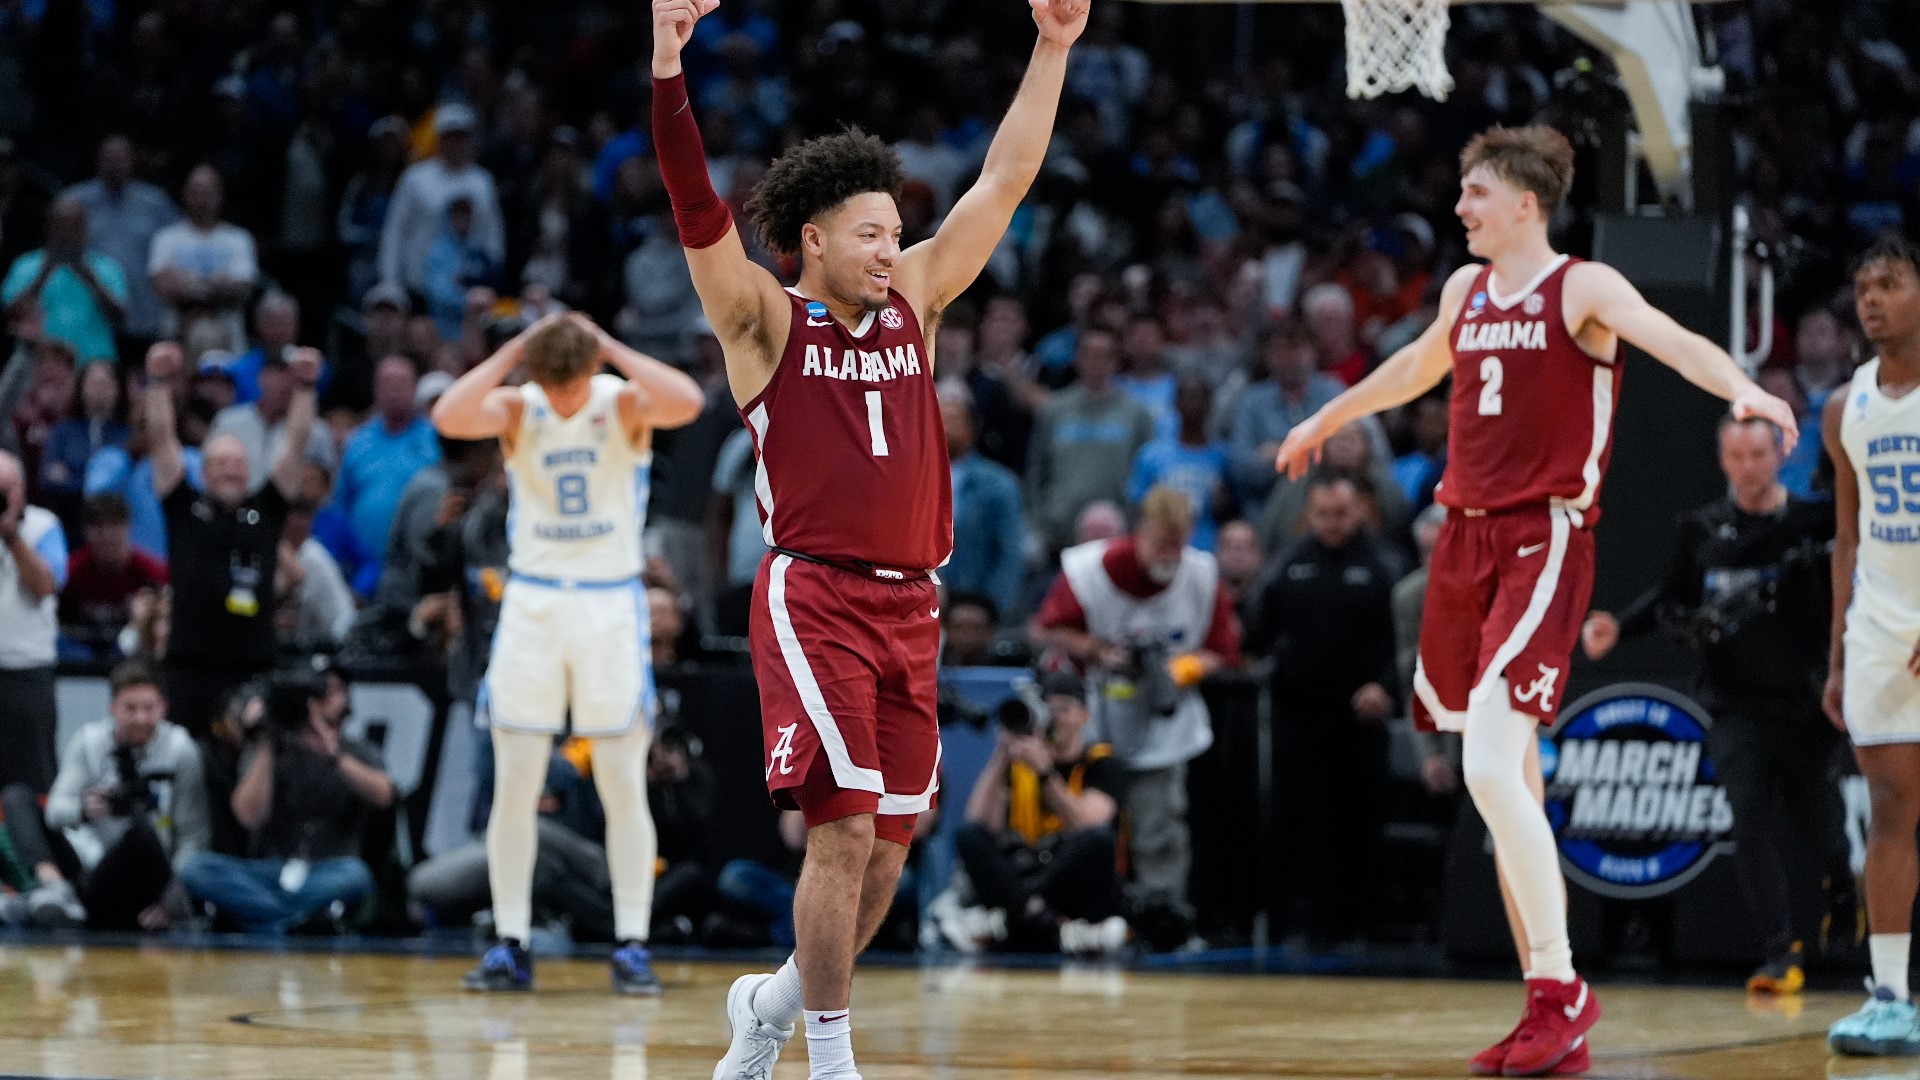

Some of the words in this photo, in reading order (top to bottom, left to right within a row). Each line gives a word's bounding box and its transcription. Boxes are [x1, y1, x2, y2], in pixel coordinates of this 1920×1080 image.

[881, 307, 902, 328] SEC
[1456, 321, 1547, 352] ALABAMA
[803, 344, 921, 382] ALABAMA
[1478, 356, 1503, 415] 2
[865, 391, 889, 456] 1
[559, 475, 587, 514] 8
[1867, 464, 1920, 514] 55
[1871, 521, 1920, 543] CAROL
[1514, 662, 1559, 712] A
[766, 722, 797, 781] A
[1556, 738, 1702, 785] MARCH
[1570, 783, 1734, 833] MADNES
